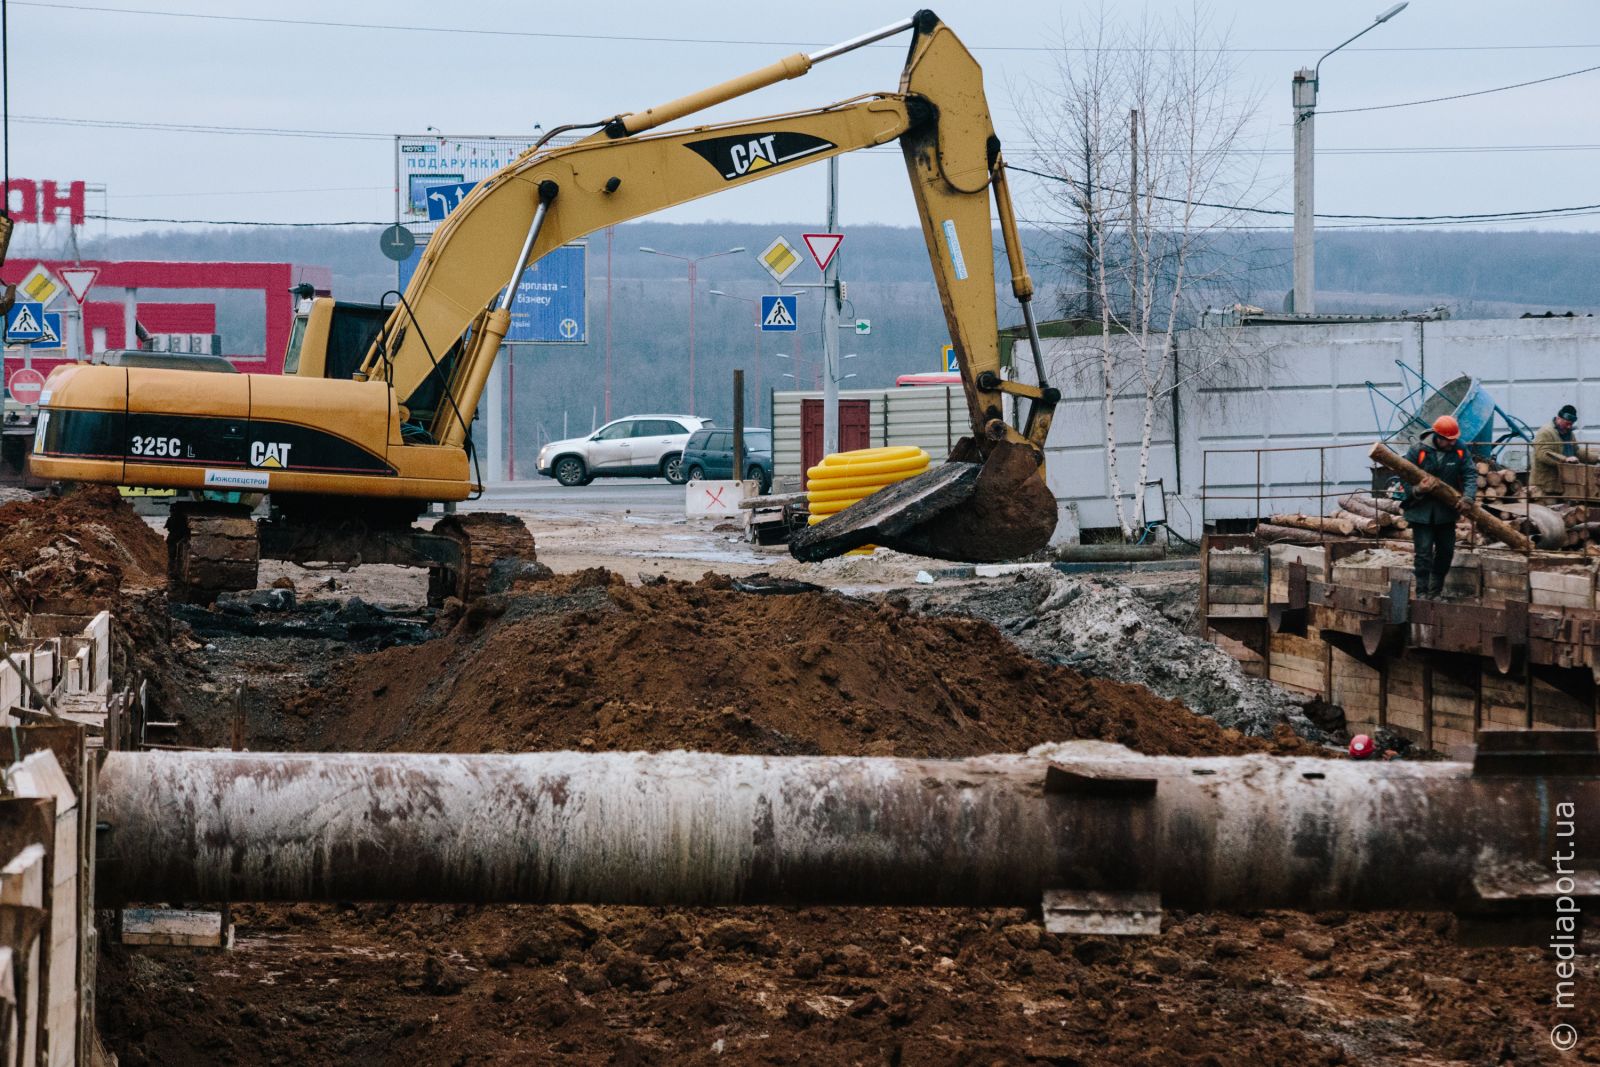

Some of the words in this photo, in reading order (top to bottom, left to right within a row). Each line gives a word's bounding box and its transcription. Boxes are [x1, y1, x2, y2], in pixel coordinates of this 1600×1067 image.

[408, 158, 499, 170] ПОДАРУНКИ
[730, 134, 777, 175] CAT
[517, 293, 551, 306] бізнесу
[131, 435, 181, 457] 325C
[187, 444, 195, 458] L
[250, 441, 292, 468] CAT
